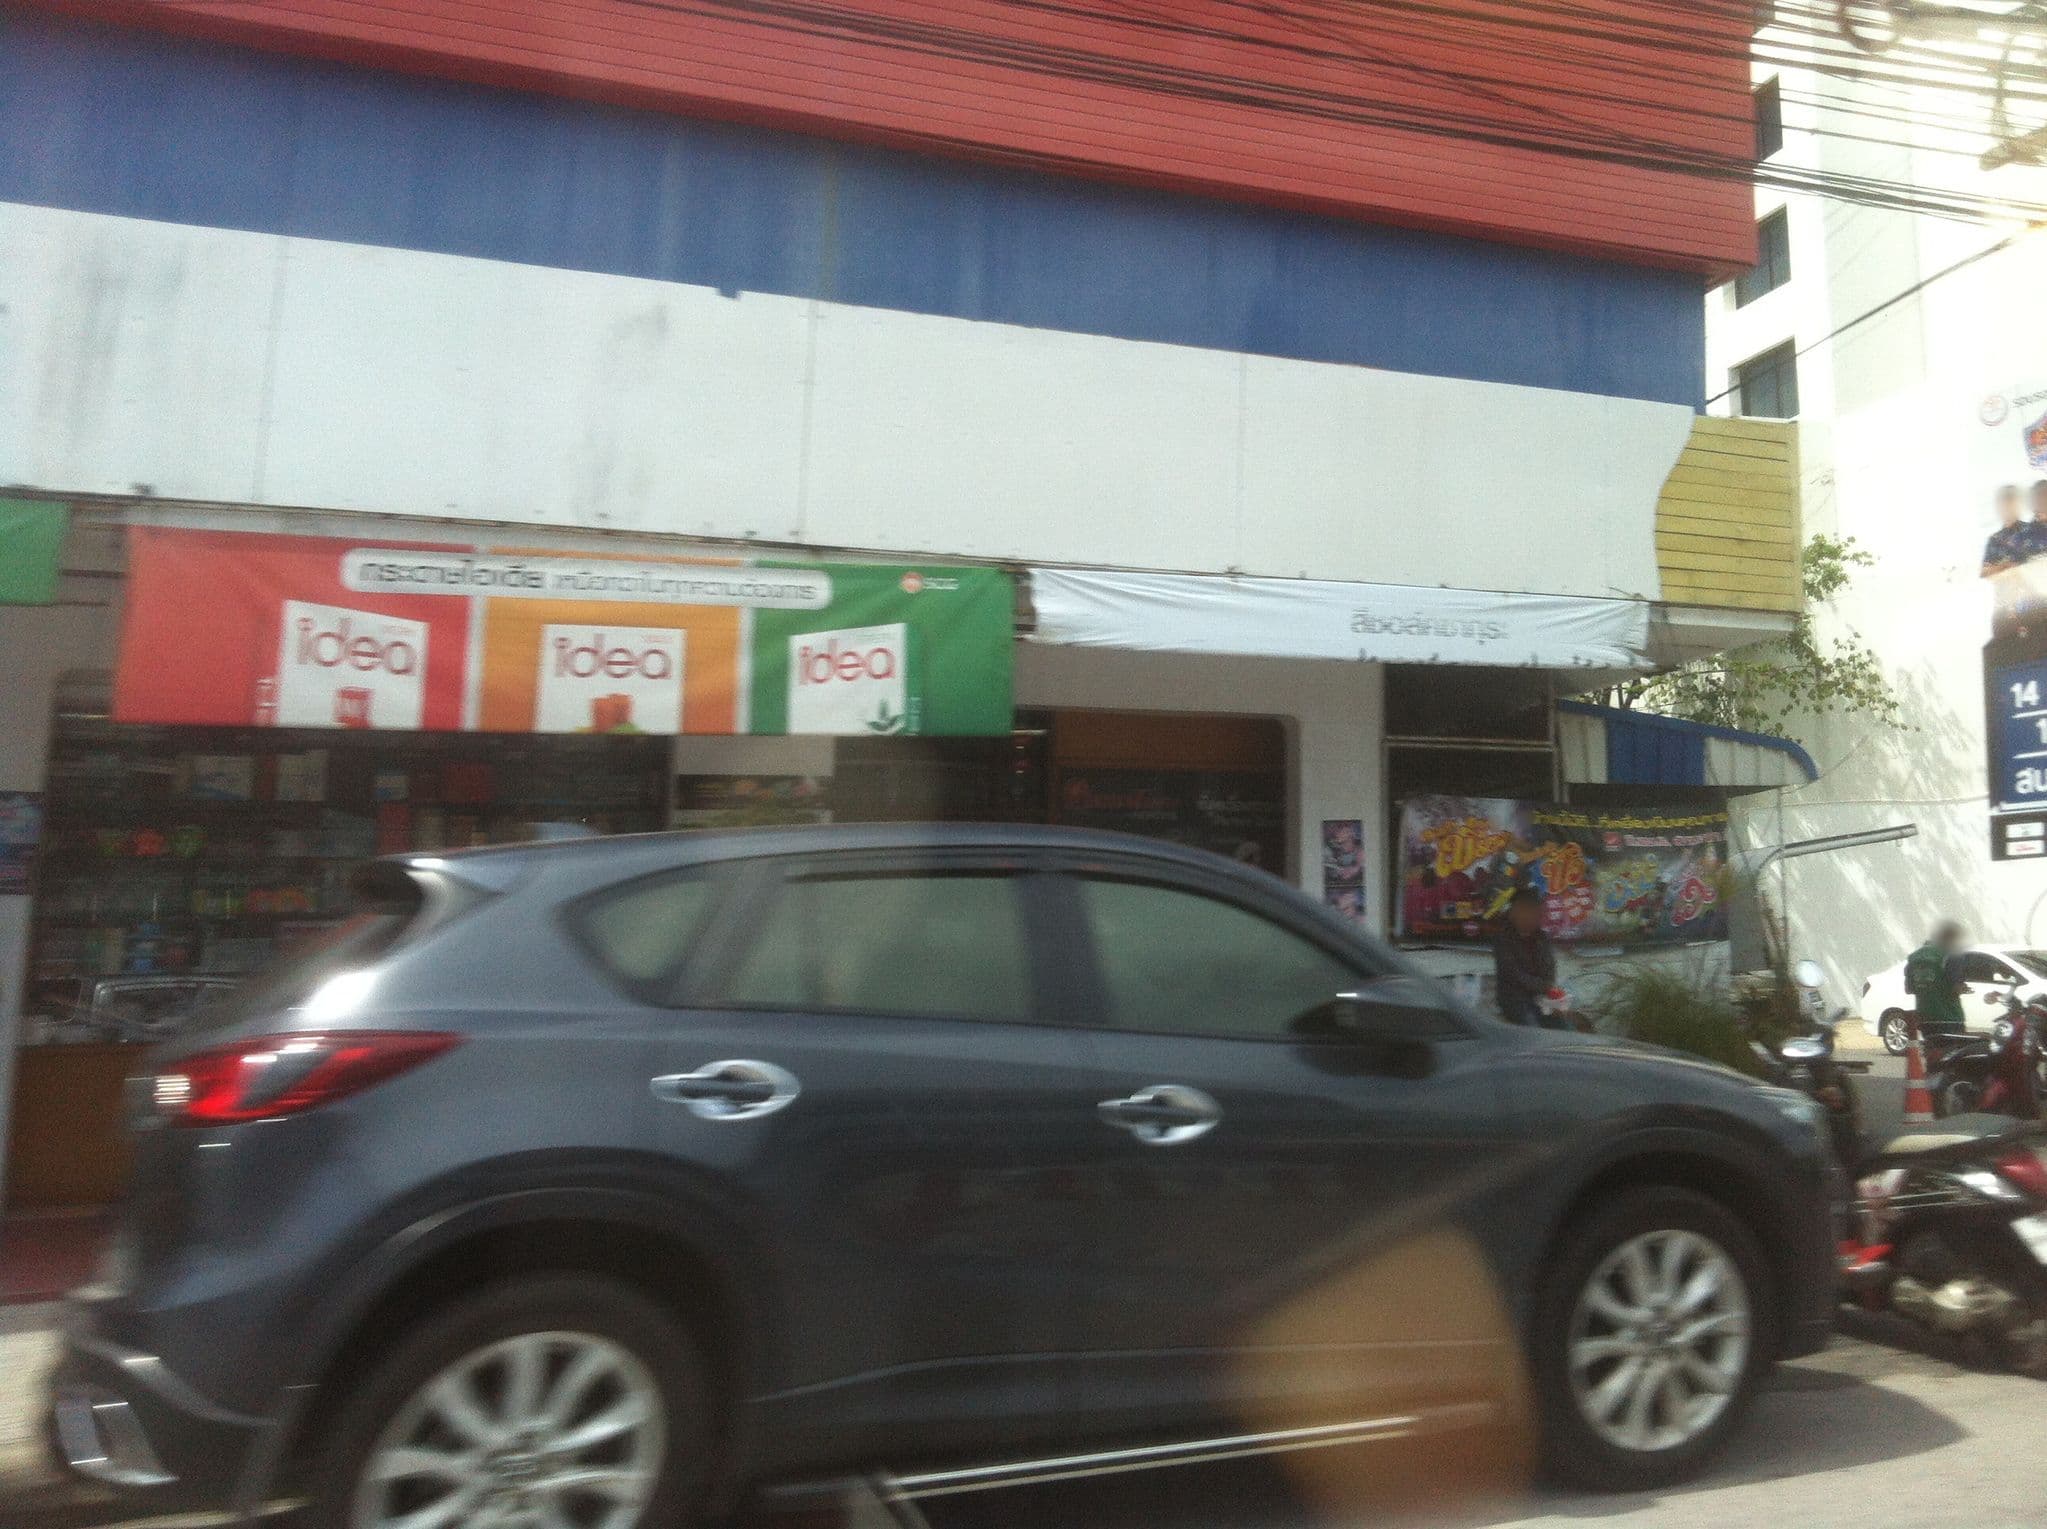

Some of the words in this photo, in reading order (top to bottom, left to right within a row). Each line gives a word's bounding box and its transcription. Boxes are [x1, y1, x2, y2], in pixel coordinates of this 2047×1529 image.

[294, 615, 417, 677] idea
[553, 634, 673, 681] idea
[797, 637, 896, 686] idea
[2010, 680, 2040, 709] 14
